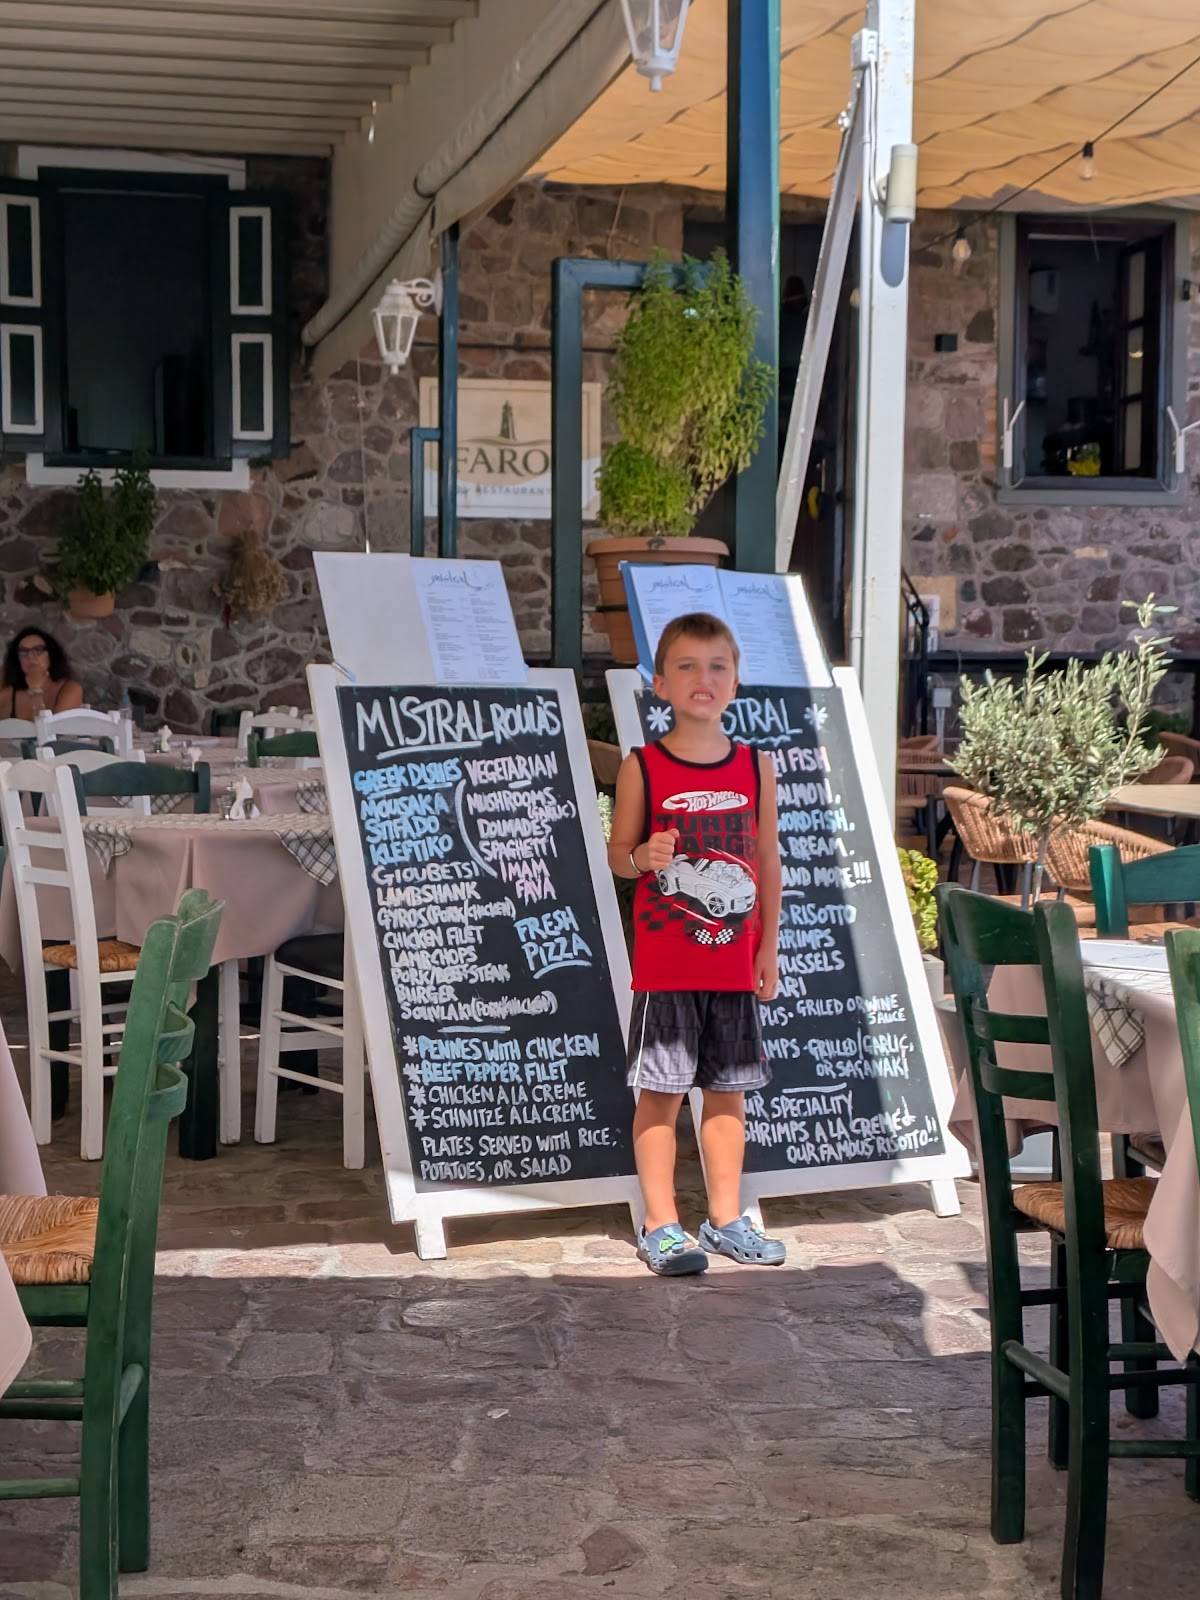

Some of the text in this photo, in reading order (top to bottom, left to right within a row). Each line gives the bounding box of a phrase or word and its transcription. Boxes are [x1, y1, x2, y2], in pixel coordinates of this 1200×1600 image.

[356, 696, 493, 751] MISTRAL
[721, 697, 803, 736] STRAL
[464, 751, 559, 787] VEGETARIAN
[789, 746, 831, 773] FISH
[354, 761, 408, 795] GREEK
[467, 786, 557, 816] MUSHROOMS
[776, 777, 841, 808] ALMON.
[364, 815, 440, 844] STIFADO
[369, 834, 454, 866] KLEFTIKO
[479, 836, 558, 863] SPAGHETTI
[371, 860, 479, 886] GIOUBETSI
[500, 858, 551, 883] IMAM
[515, 876, 557, 906] FAVA
[514, 906, 580, 943] FRESH
[790, 903, 857, 926] RISOTTO
[383, 925, 484, 950] CHICKEN FILET
[777, 928, 835, 950] HRIMPS
[522, 933, 592, 972] PIZZA
[394, 984, 459, 1005] BURGER
[865, 994, 899, 1012] WINE
[868, 1008, 907, 1024] SAUCE
[417, 1032, 600, 1062] PENNES WITH CHICKEN
[763, 1038, 801, 1060] IMPS
[421, 1059, 569, 1085] BEEF PEPPER FILET
[816, 1060, 836, 1079] OR
[429, 1081, 587, 1106] CHICKEN A LA CREME
[744, 1090, 853, 1121] UR SPECIALITY
[541, 1099, 597, 1124] CREME
[814, 1121, 827, 1144] A
[828, 1117, 850, 1141] LA
[850, 1107, 902, 1138] CREME
[421, 1136, 474, 1157] PLATES
[478, 1134, 532, 1157] SERVED
[536, 1131, 571, 1152] WITH
[786, 1145, 820, 1165] OUR
[819, 1137, 875, 1163] FAMOUS
[493, 1159, 518, 1179] OR
[520, 1153, 573, 1179] SALAD
